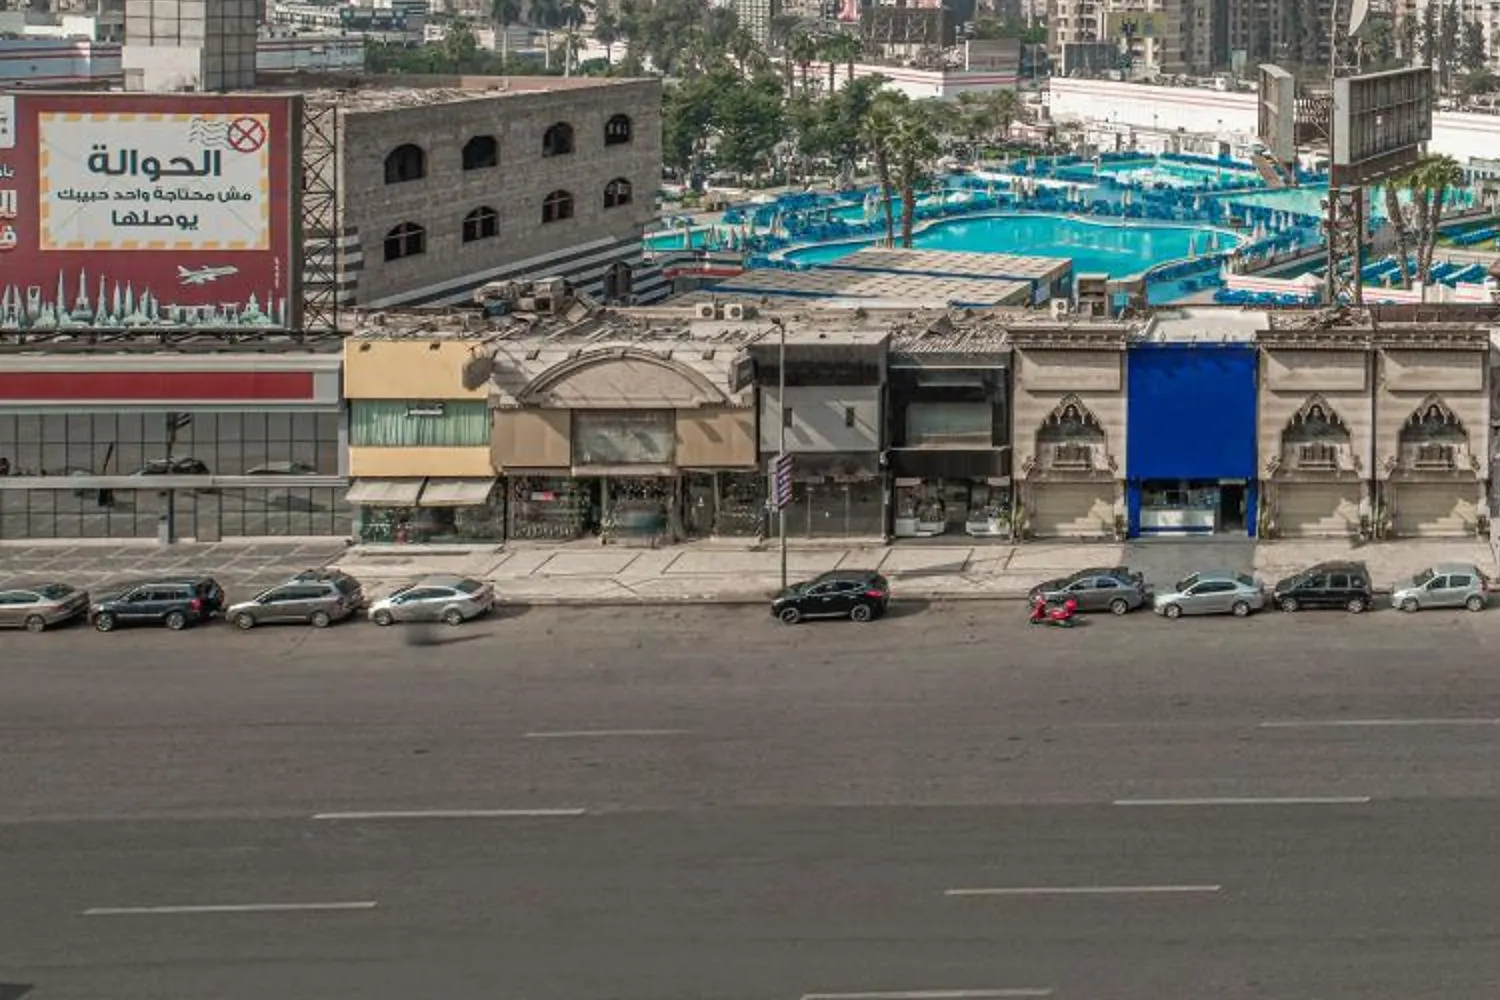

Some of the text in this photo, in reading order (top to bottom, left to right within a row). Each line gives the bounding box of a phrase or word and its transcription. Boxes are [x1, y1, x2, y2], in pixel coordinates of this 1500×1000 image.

[87, 144, 221, 182] الحوالة
[57, 186, 252, 203] مش محتاجة واحد حبيبك
[111, 209, 198, 230] يوصلها
